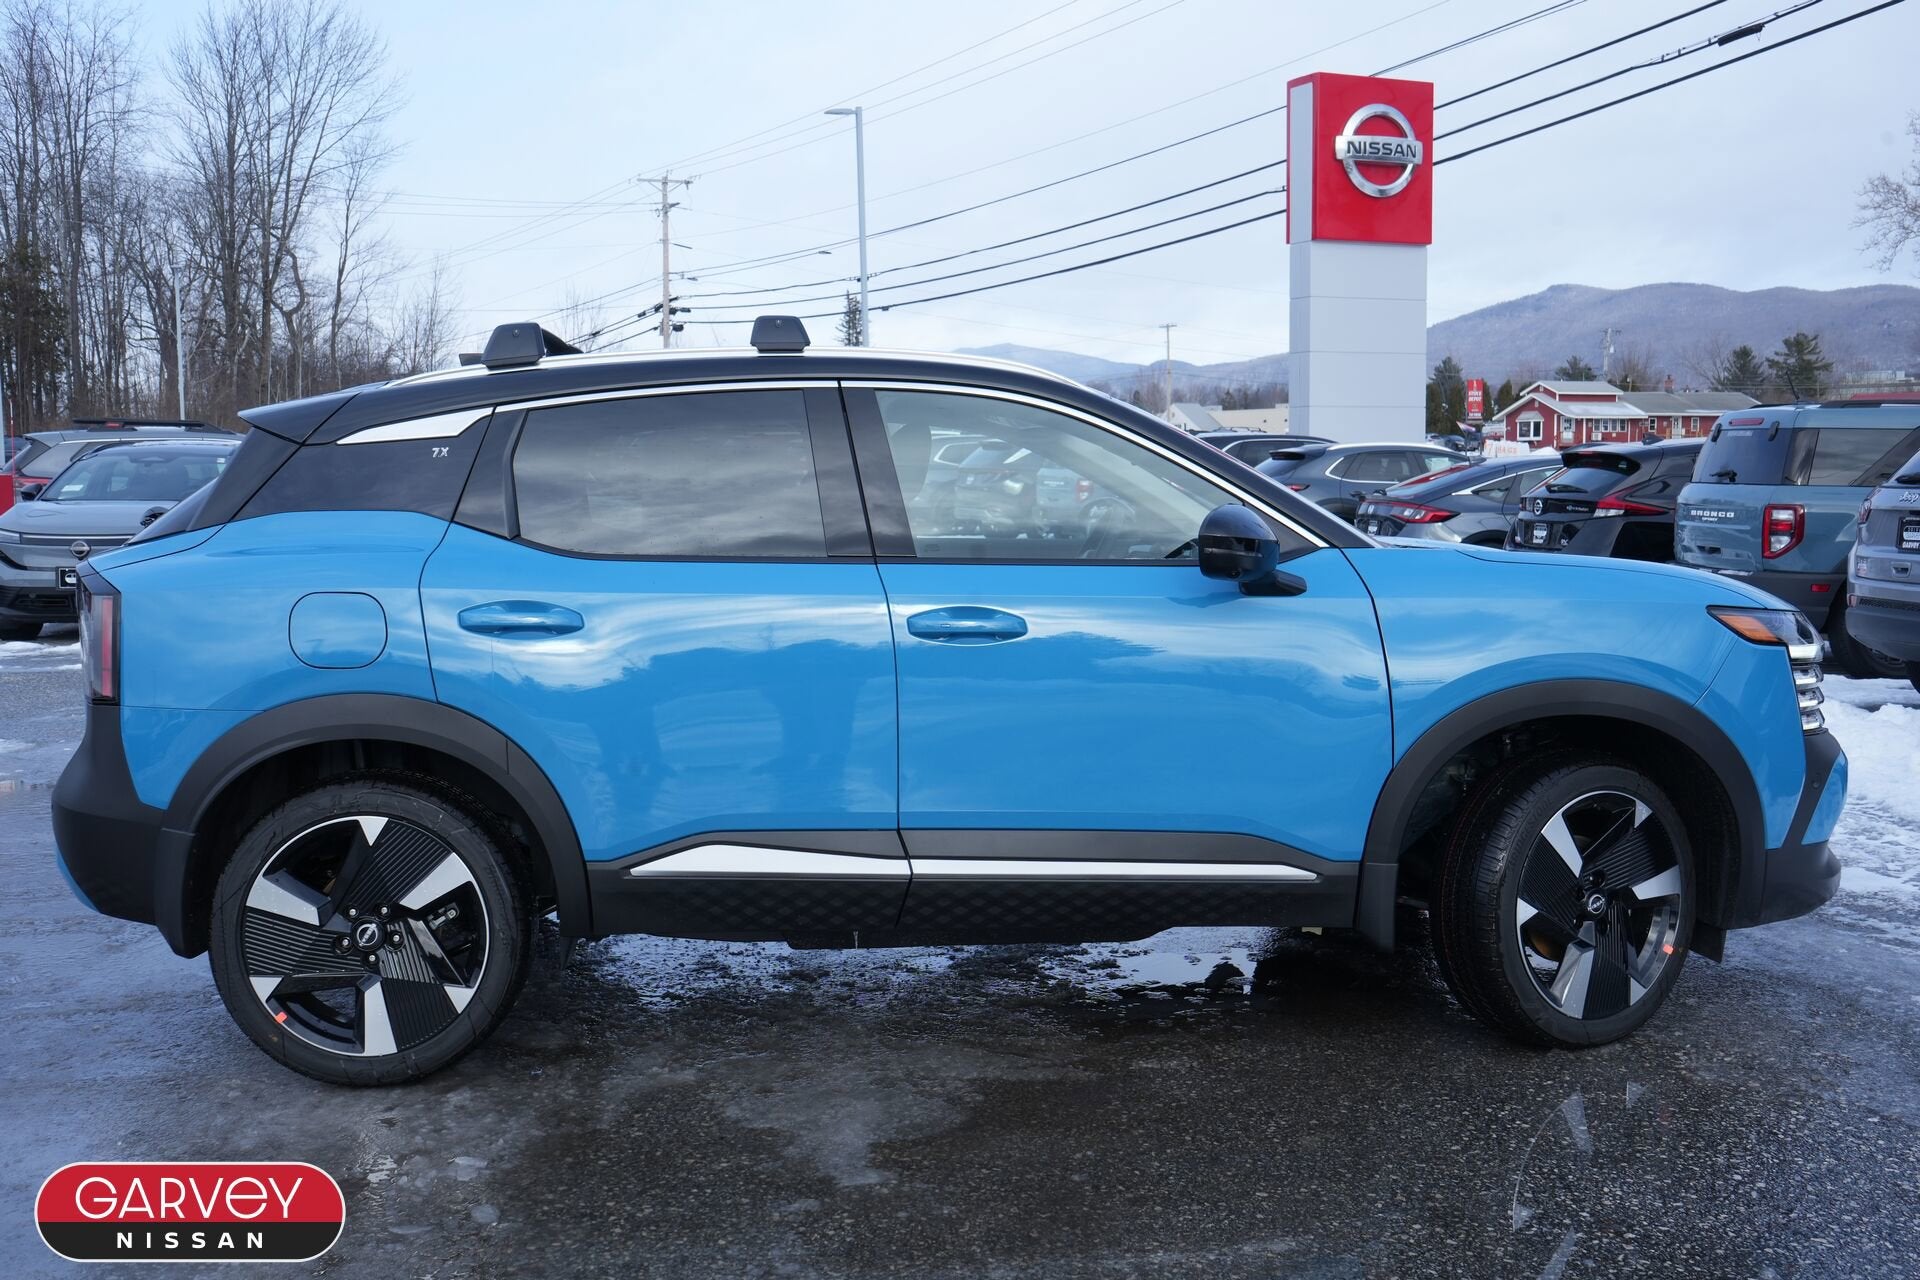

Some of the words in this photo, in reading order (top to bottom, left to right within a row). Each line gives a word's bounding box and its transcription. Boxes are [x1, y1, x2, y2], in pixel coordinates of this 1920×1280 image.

[1347, 141, 1417, 158] NISSAN
[1900, 491, 1919, 504] Jeep
[1690, 510, 1735, 518] BRONCO
